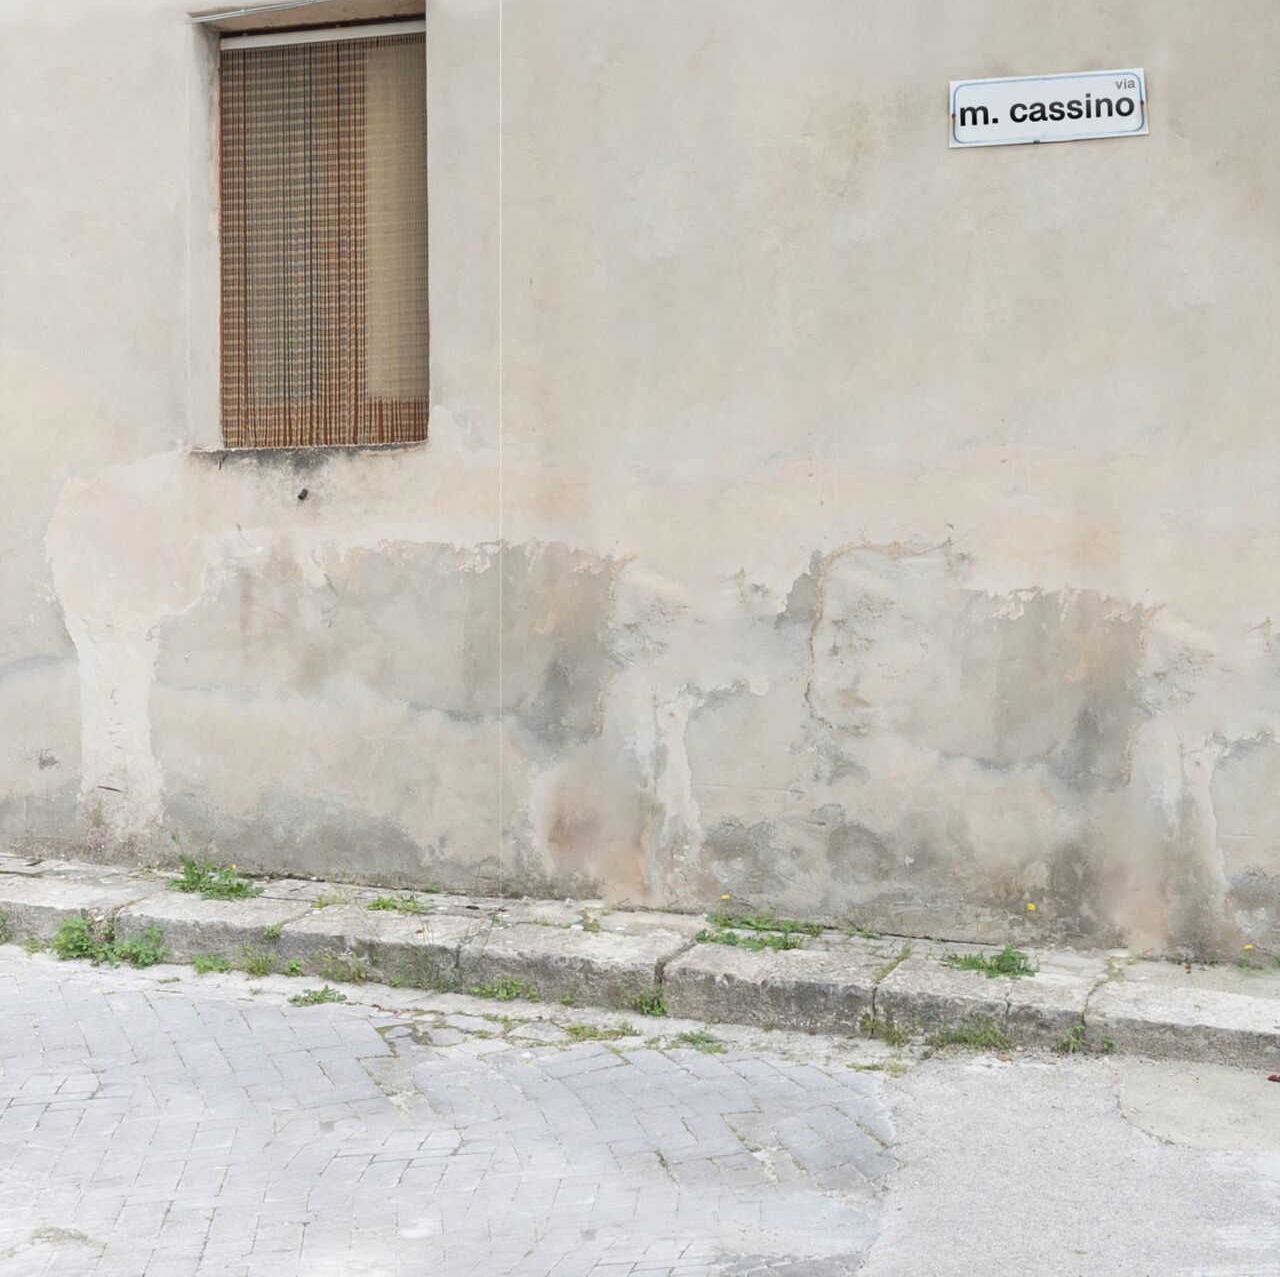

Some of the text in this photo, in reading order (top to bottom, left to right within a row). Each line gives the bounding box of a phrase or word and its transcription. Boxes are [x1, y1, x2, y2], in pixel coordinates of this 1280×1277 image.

[1115, 79, 1136, 90] via
[960, 93, 1135, 126] m. cassino
